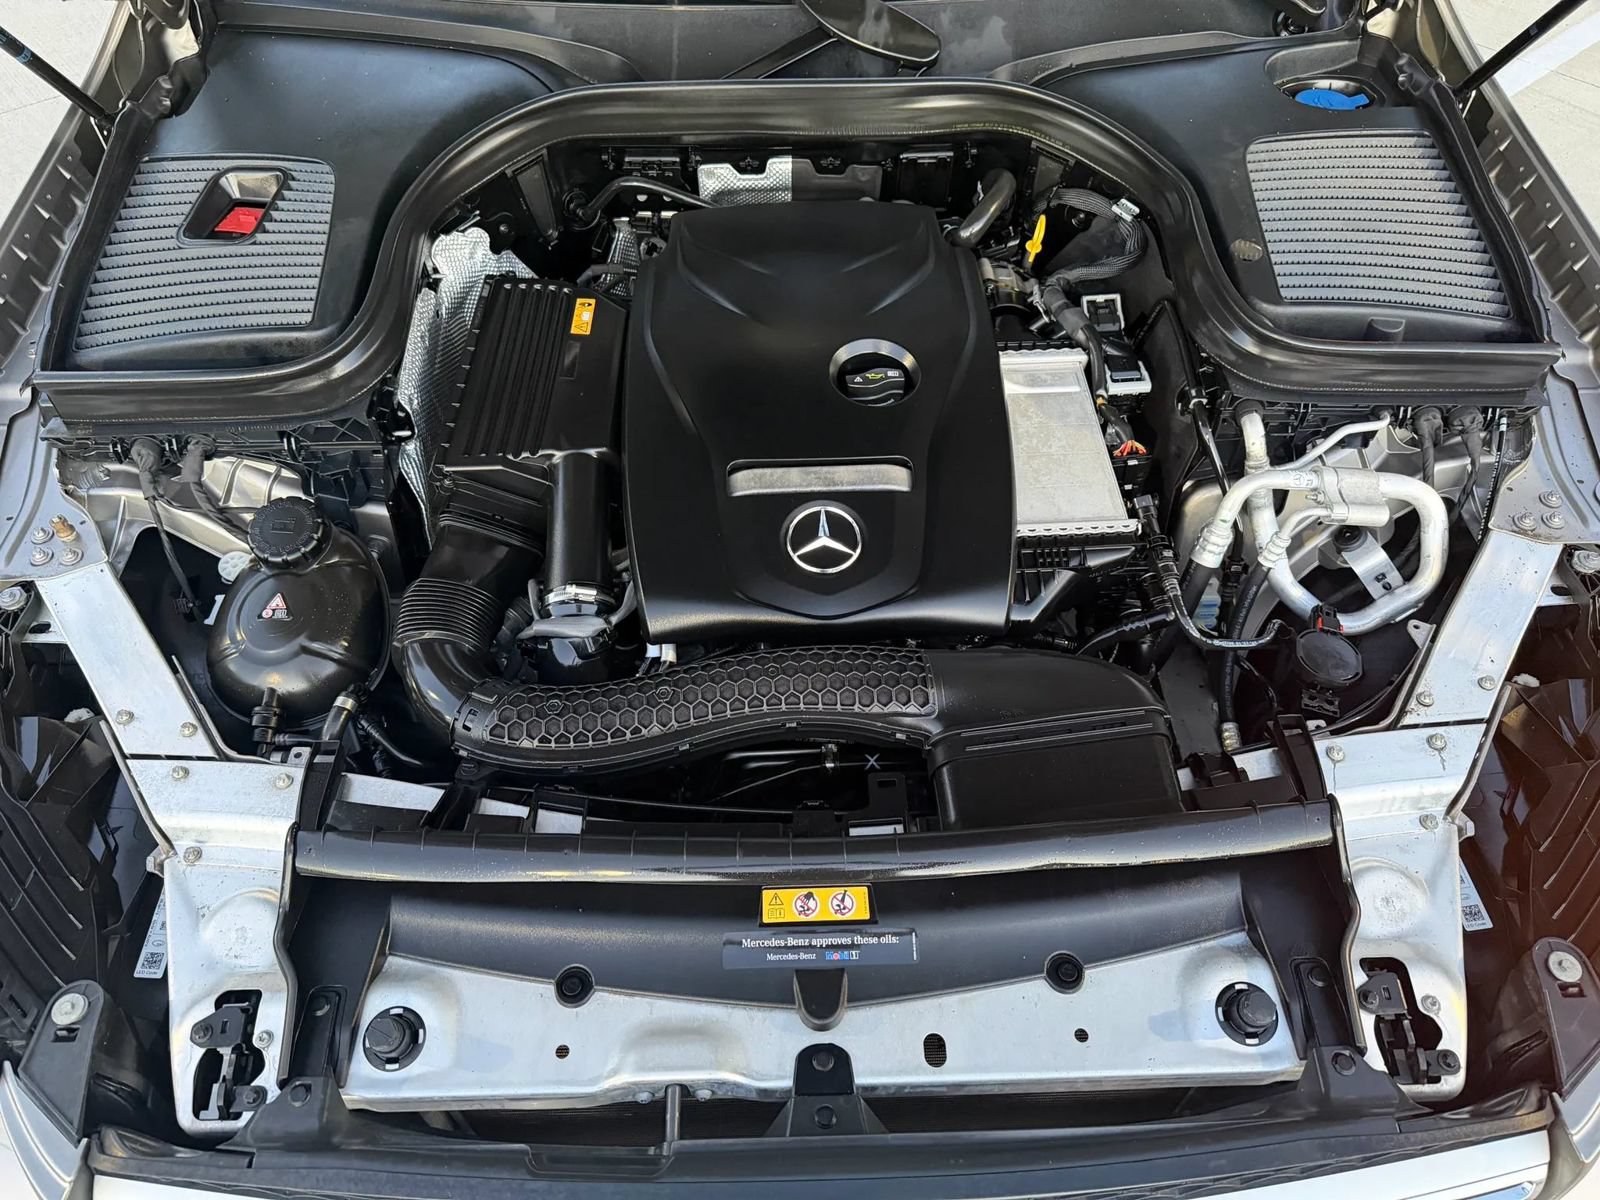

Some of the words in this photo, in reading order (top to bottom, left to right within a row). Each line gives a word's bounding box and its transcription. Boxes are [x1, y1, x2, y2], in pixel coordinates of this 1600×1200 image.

[742, 937, 810, 948] Mercedes-Benz
[811, 936, 852, 948] approves
[854, 935, 879, 945] these
[880, 934, 900, 944] oils:
[766, 952, 817, 961] Mercedes-Benz
